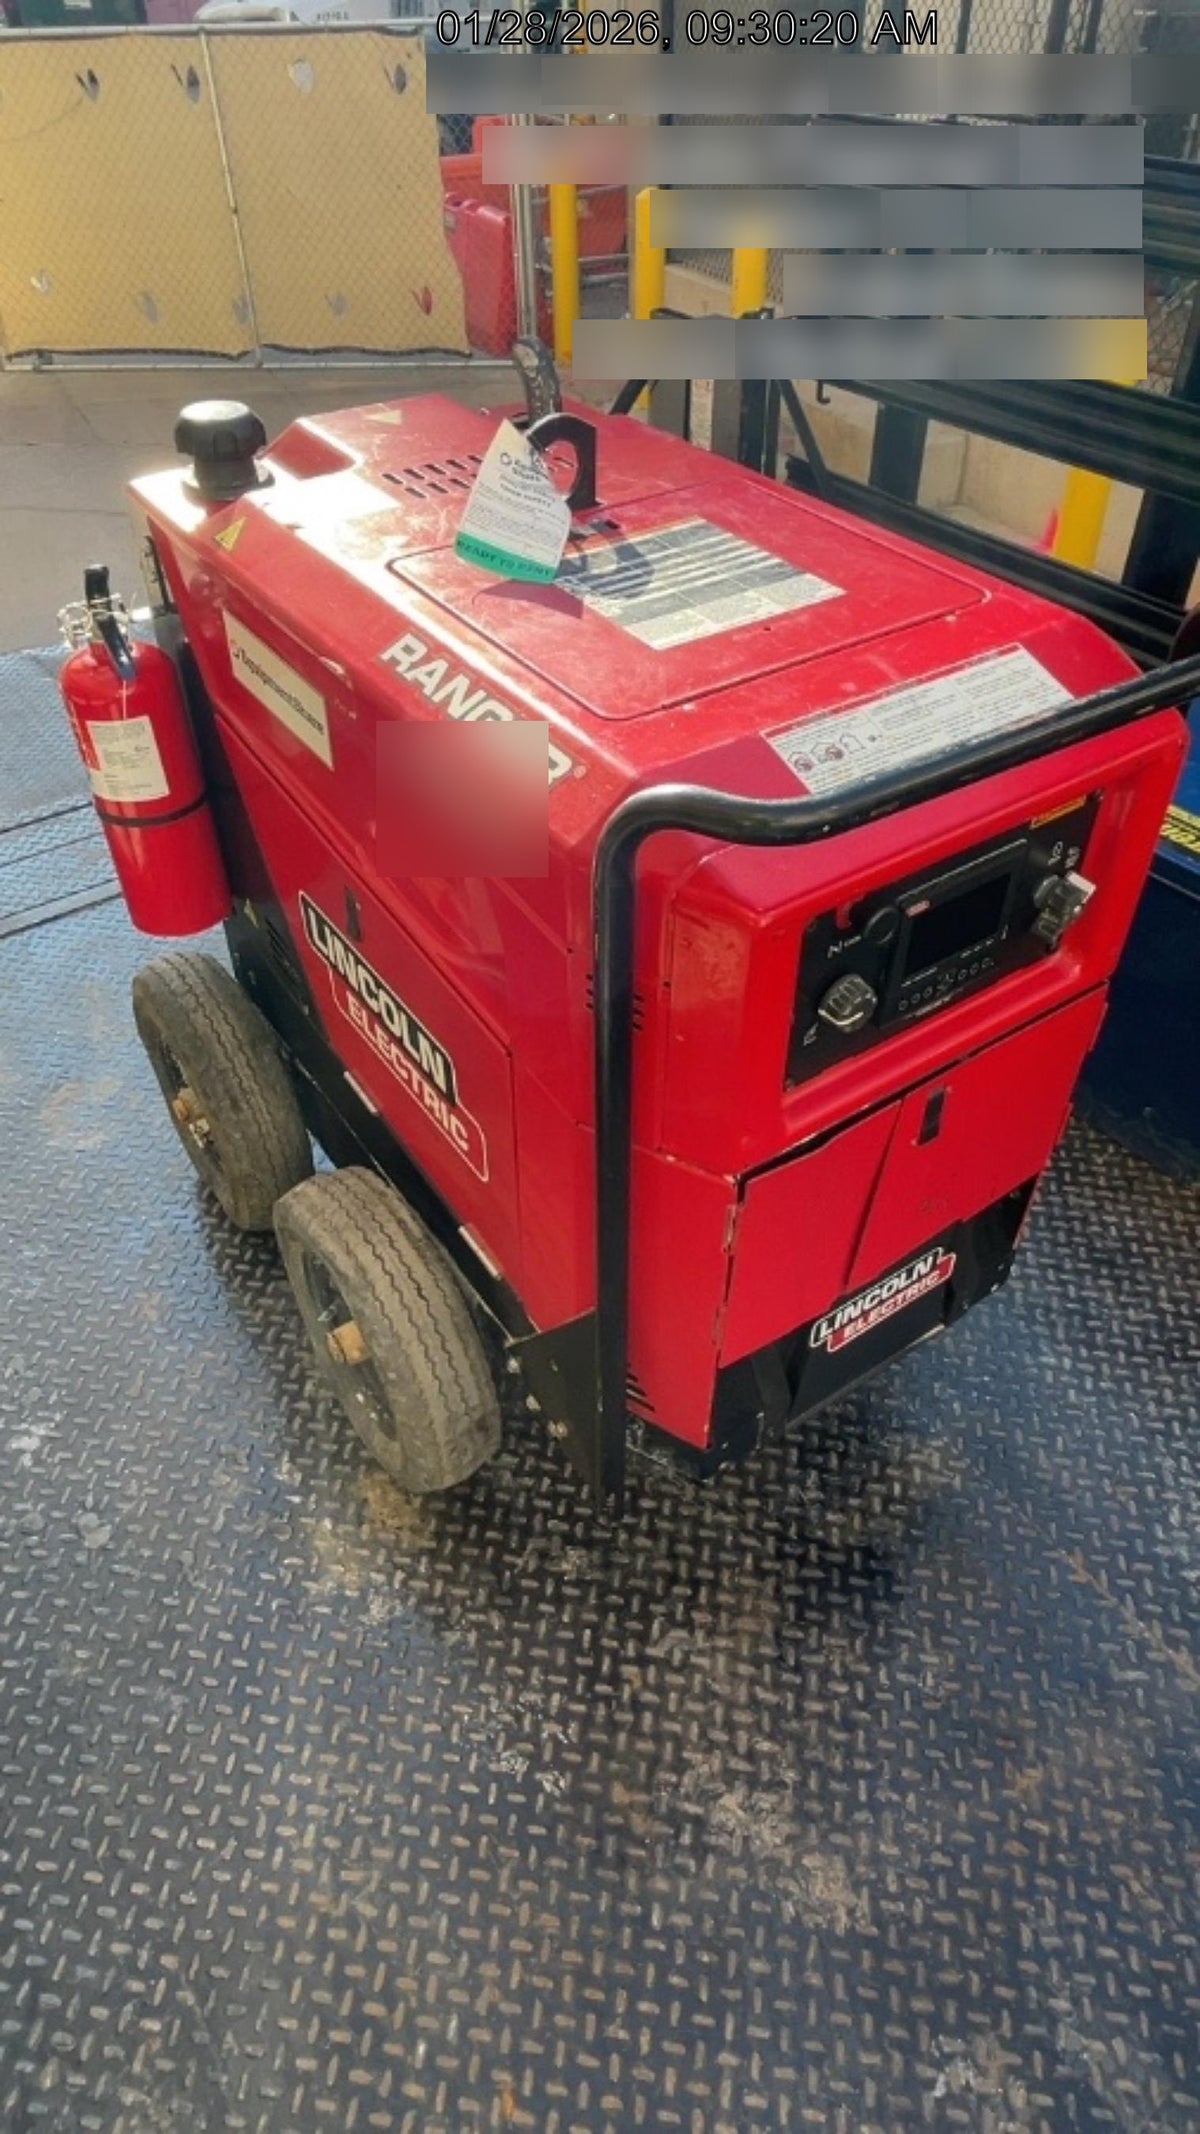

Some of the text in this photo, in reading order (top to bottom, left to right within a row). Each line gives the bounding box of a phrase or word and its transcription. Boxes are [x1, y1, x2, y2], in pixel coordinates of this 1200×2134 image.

[307, 906, 448, 1094] LINCOLN
[346, 990, 469, 1151] ELECTRIC
[820, 1255, 934, 1338] LINCOLN
[844, 1270, 941, 1338] ELECTRIC
